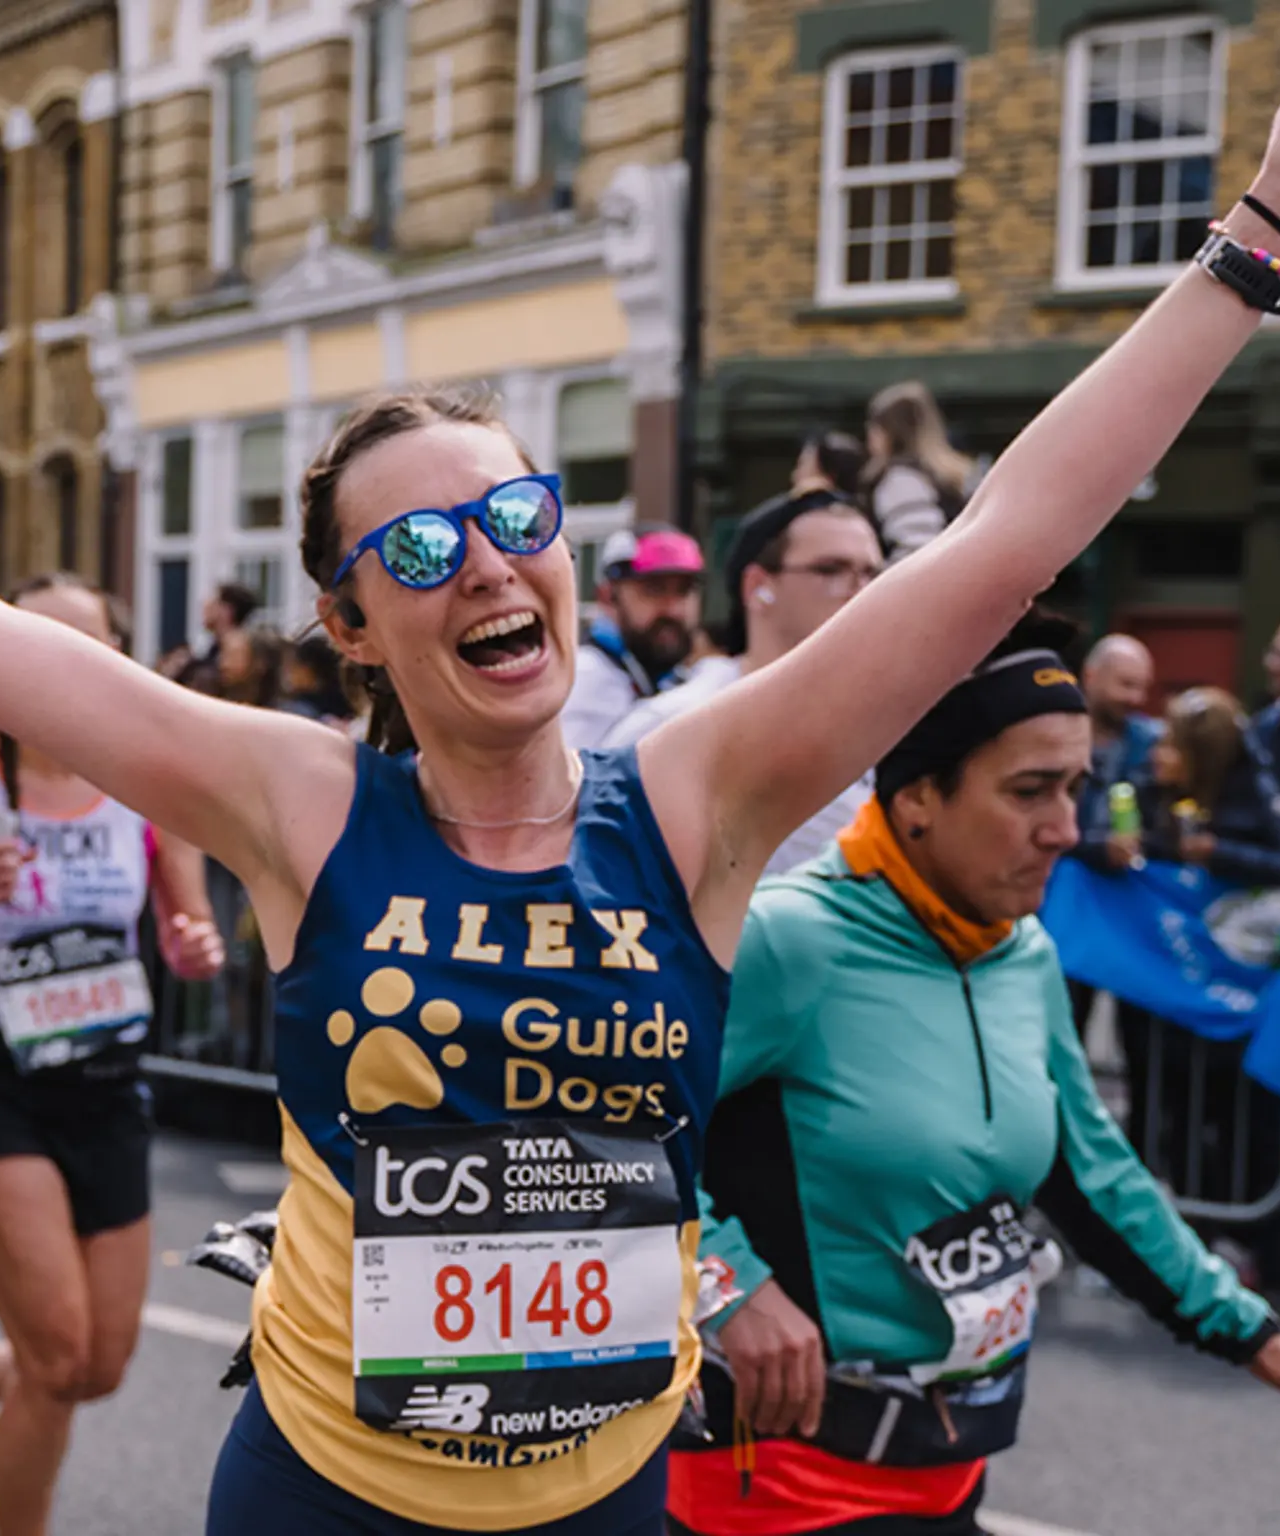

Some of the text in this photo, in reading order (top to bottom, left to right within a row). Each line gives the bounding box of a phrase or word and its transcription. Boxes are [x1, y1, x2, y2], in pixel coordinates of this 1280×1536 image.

[363, 896, 660, 972] ALEX
[501, 997, 689, 1060] Guide
[504, 1058, 666, 1122] Dogs
[502, 1137, 573, 1160] TATA
[502, 1162, 656, 1188] CONSULTANCY
[374, 1145, 492, 1218] tcs
[503, 1189, 608, 1215] SERVICES
[432, 1258, 614, 1343] 8148
[490, 1411, 547, 1435] new
